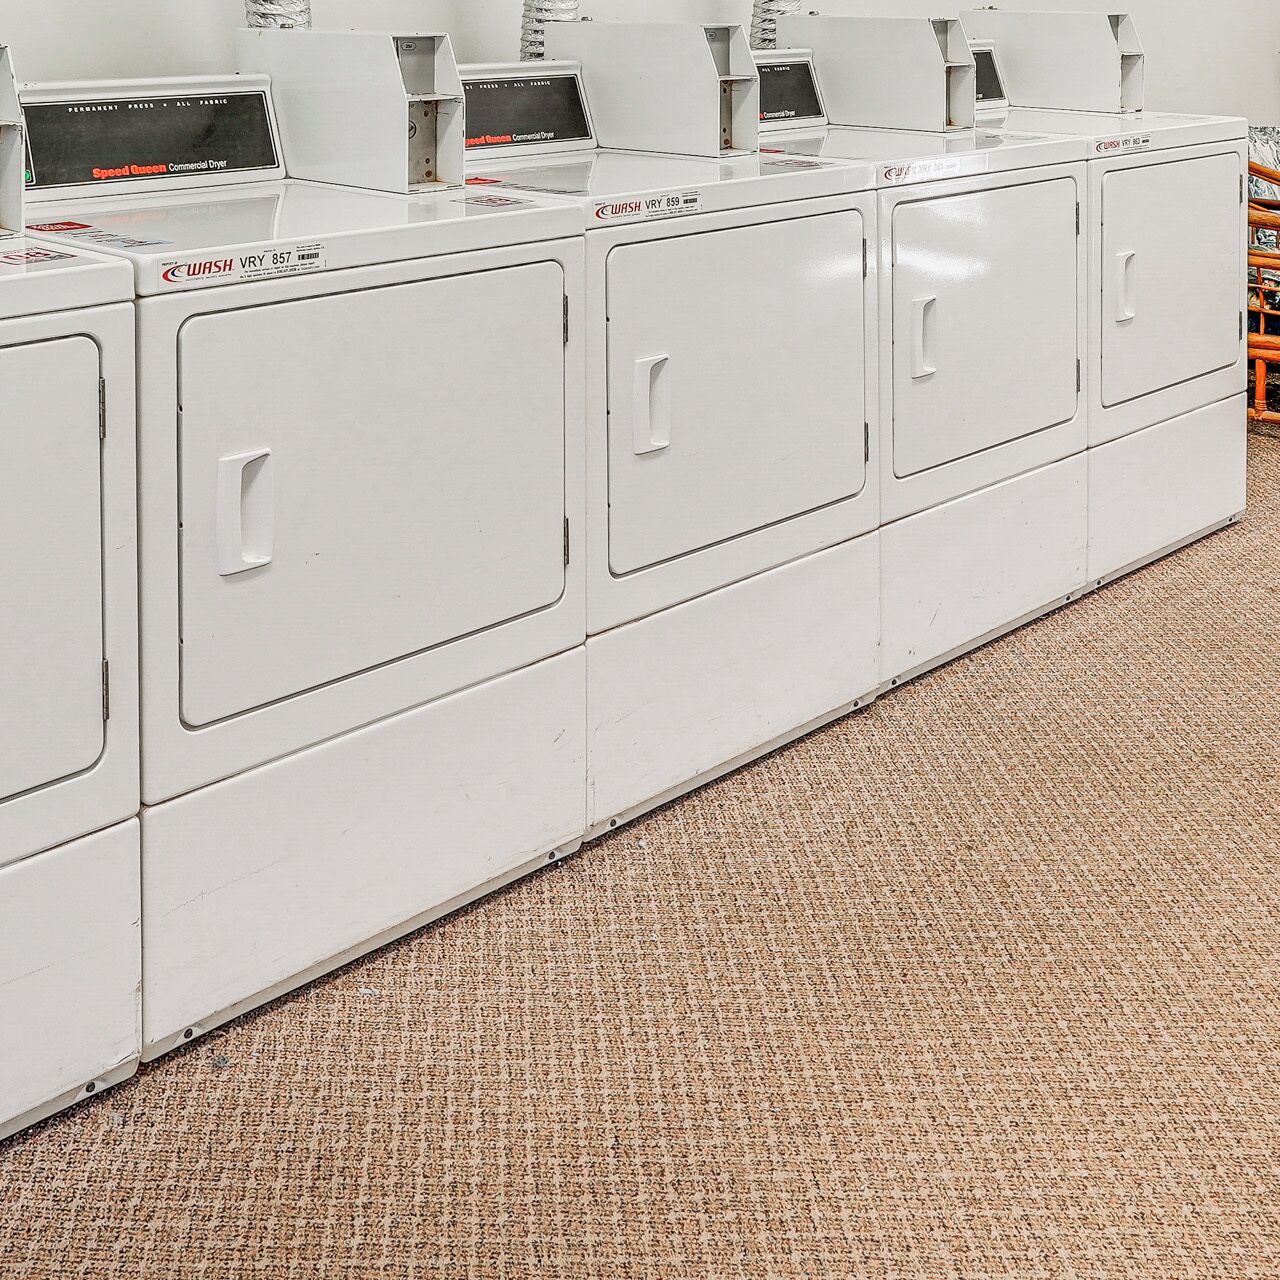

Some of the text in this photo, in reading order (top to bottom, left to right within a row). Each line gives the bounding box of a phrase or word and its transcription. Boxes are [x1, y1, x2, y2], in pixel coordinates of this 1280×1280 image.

[68, 104, 119, 113] PERMANENT
[485, 134, 512, 143] Queen
[512, 132, 541, 141] Commercial
[541, 131, 555, 139] Dryer
[92, 159, 228, 179] Speed Queen Commercial Dryer
[611, 196, 680, 215] WASH VRY 859
[186, 258, 233, 276] WASH
[239, 254, 266, 269] VRY
[272, 252, 292, 265] 857
